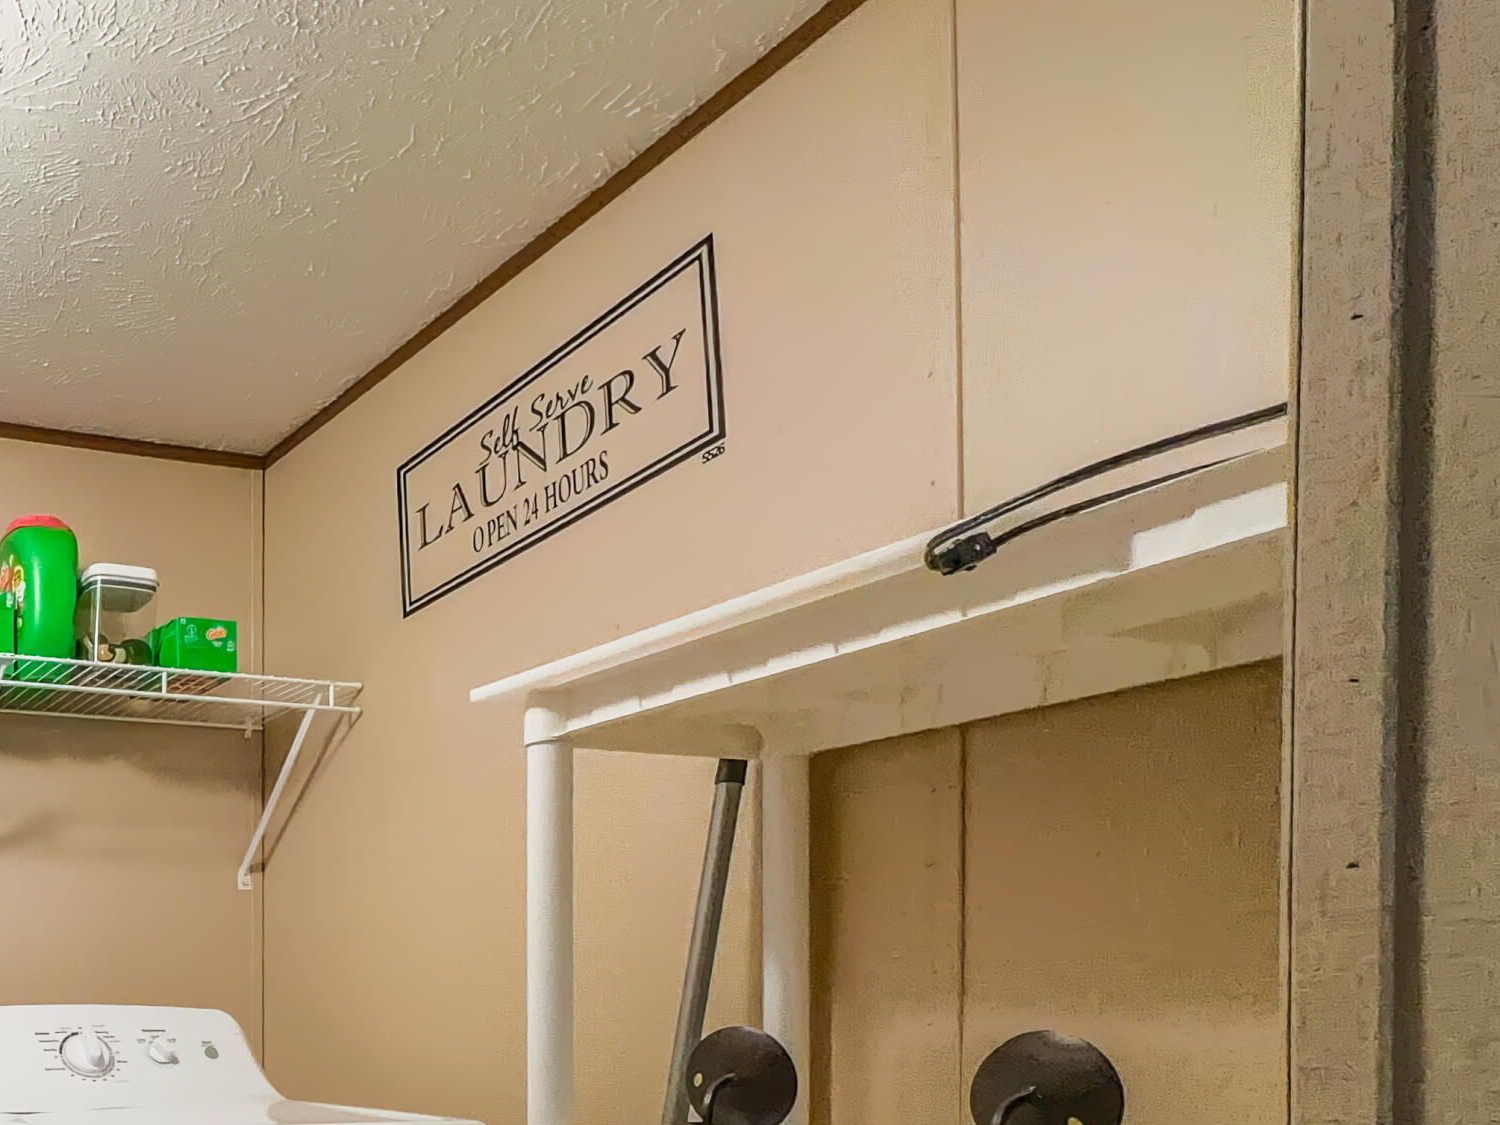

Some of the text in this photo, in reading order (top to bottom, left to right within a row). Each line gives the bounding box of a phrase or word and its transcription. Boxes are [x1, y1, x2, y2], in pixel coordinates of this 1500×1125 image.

[415, 328, 687, 552] LAUNDRY
[479, 374, 594, 467] Self Serve
[473, 450, 610, 553] OPEN 24 HOURS
